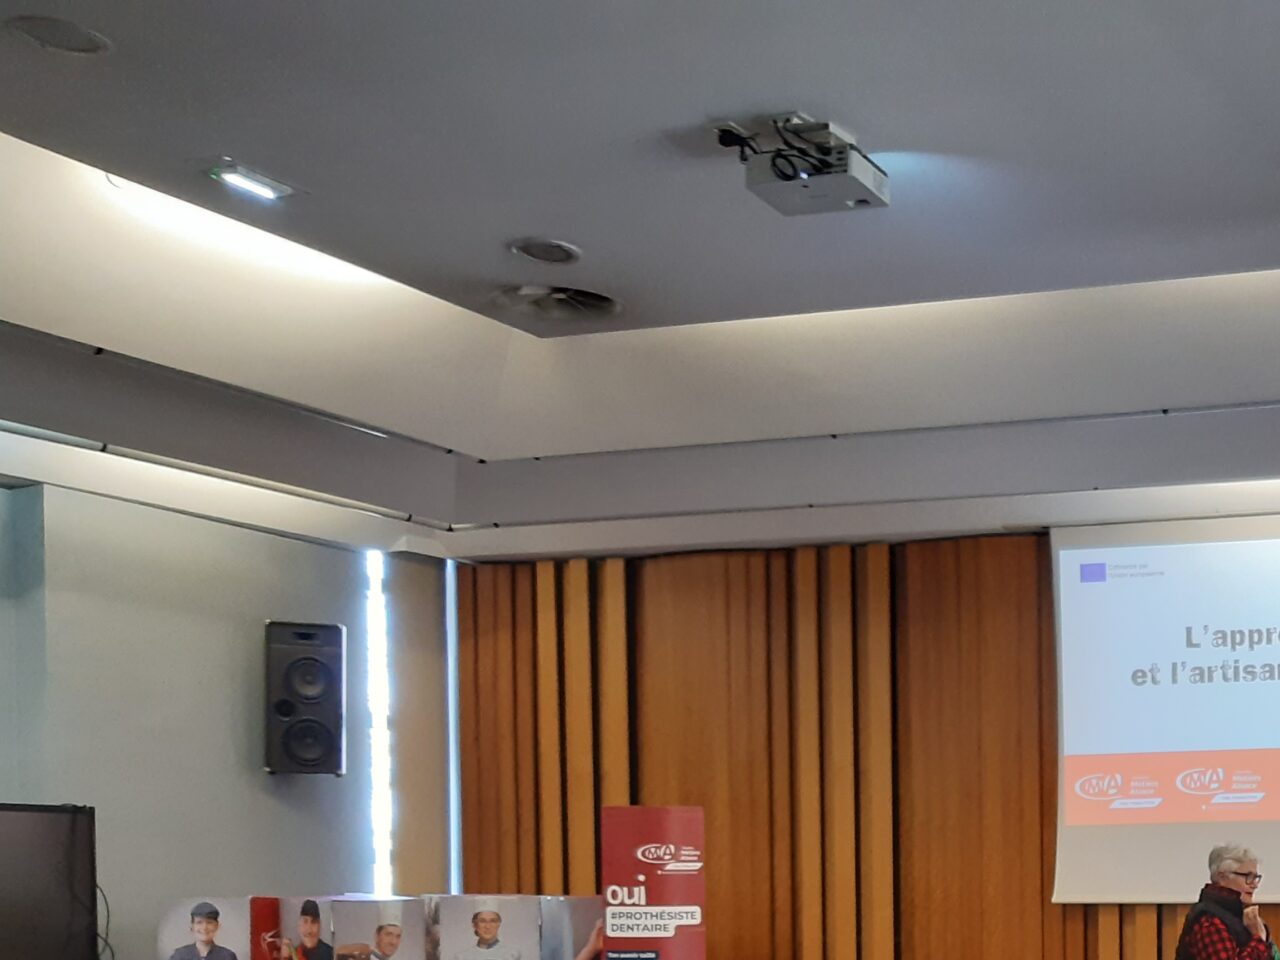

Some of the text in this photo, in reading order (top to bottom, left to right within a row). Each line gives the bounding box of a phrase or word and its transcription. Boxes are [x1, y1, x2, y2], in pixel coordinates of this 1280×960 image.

[1131, 662, 1161, 687] et
[611, 910, 697, 921] #PROTHÉSISTE
[611, 923, 670, 932] DENTAIRE
